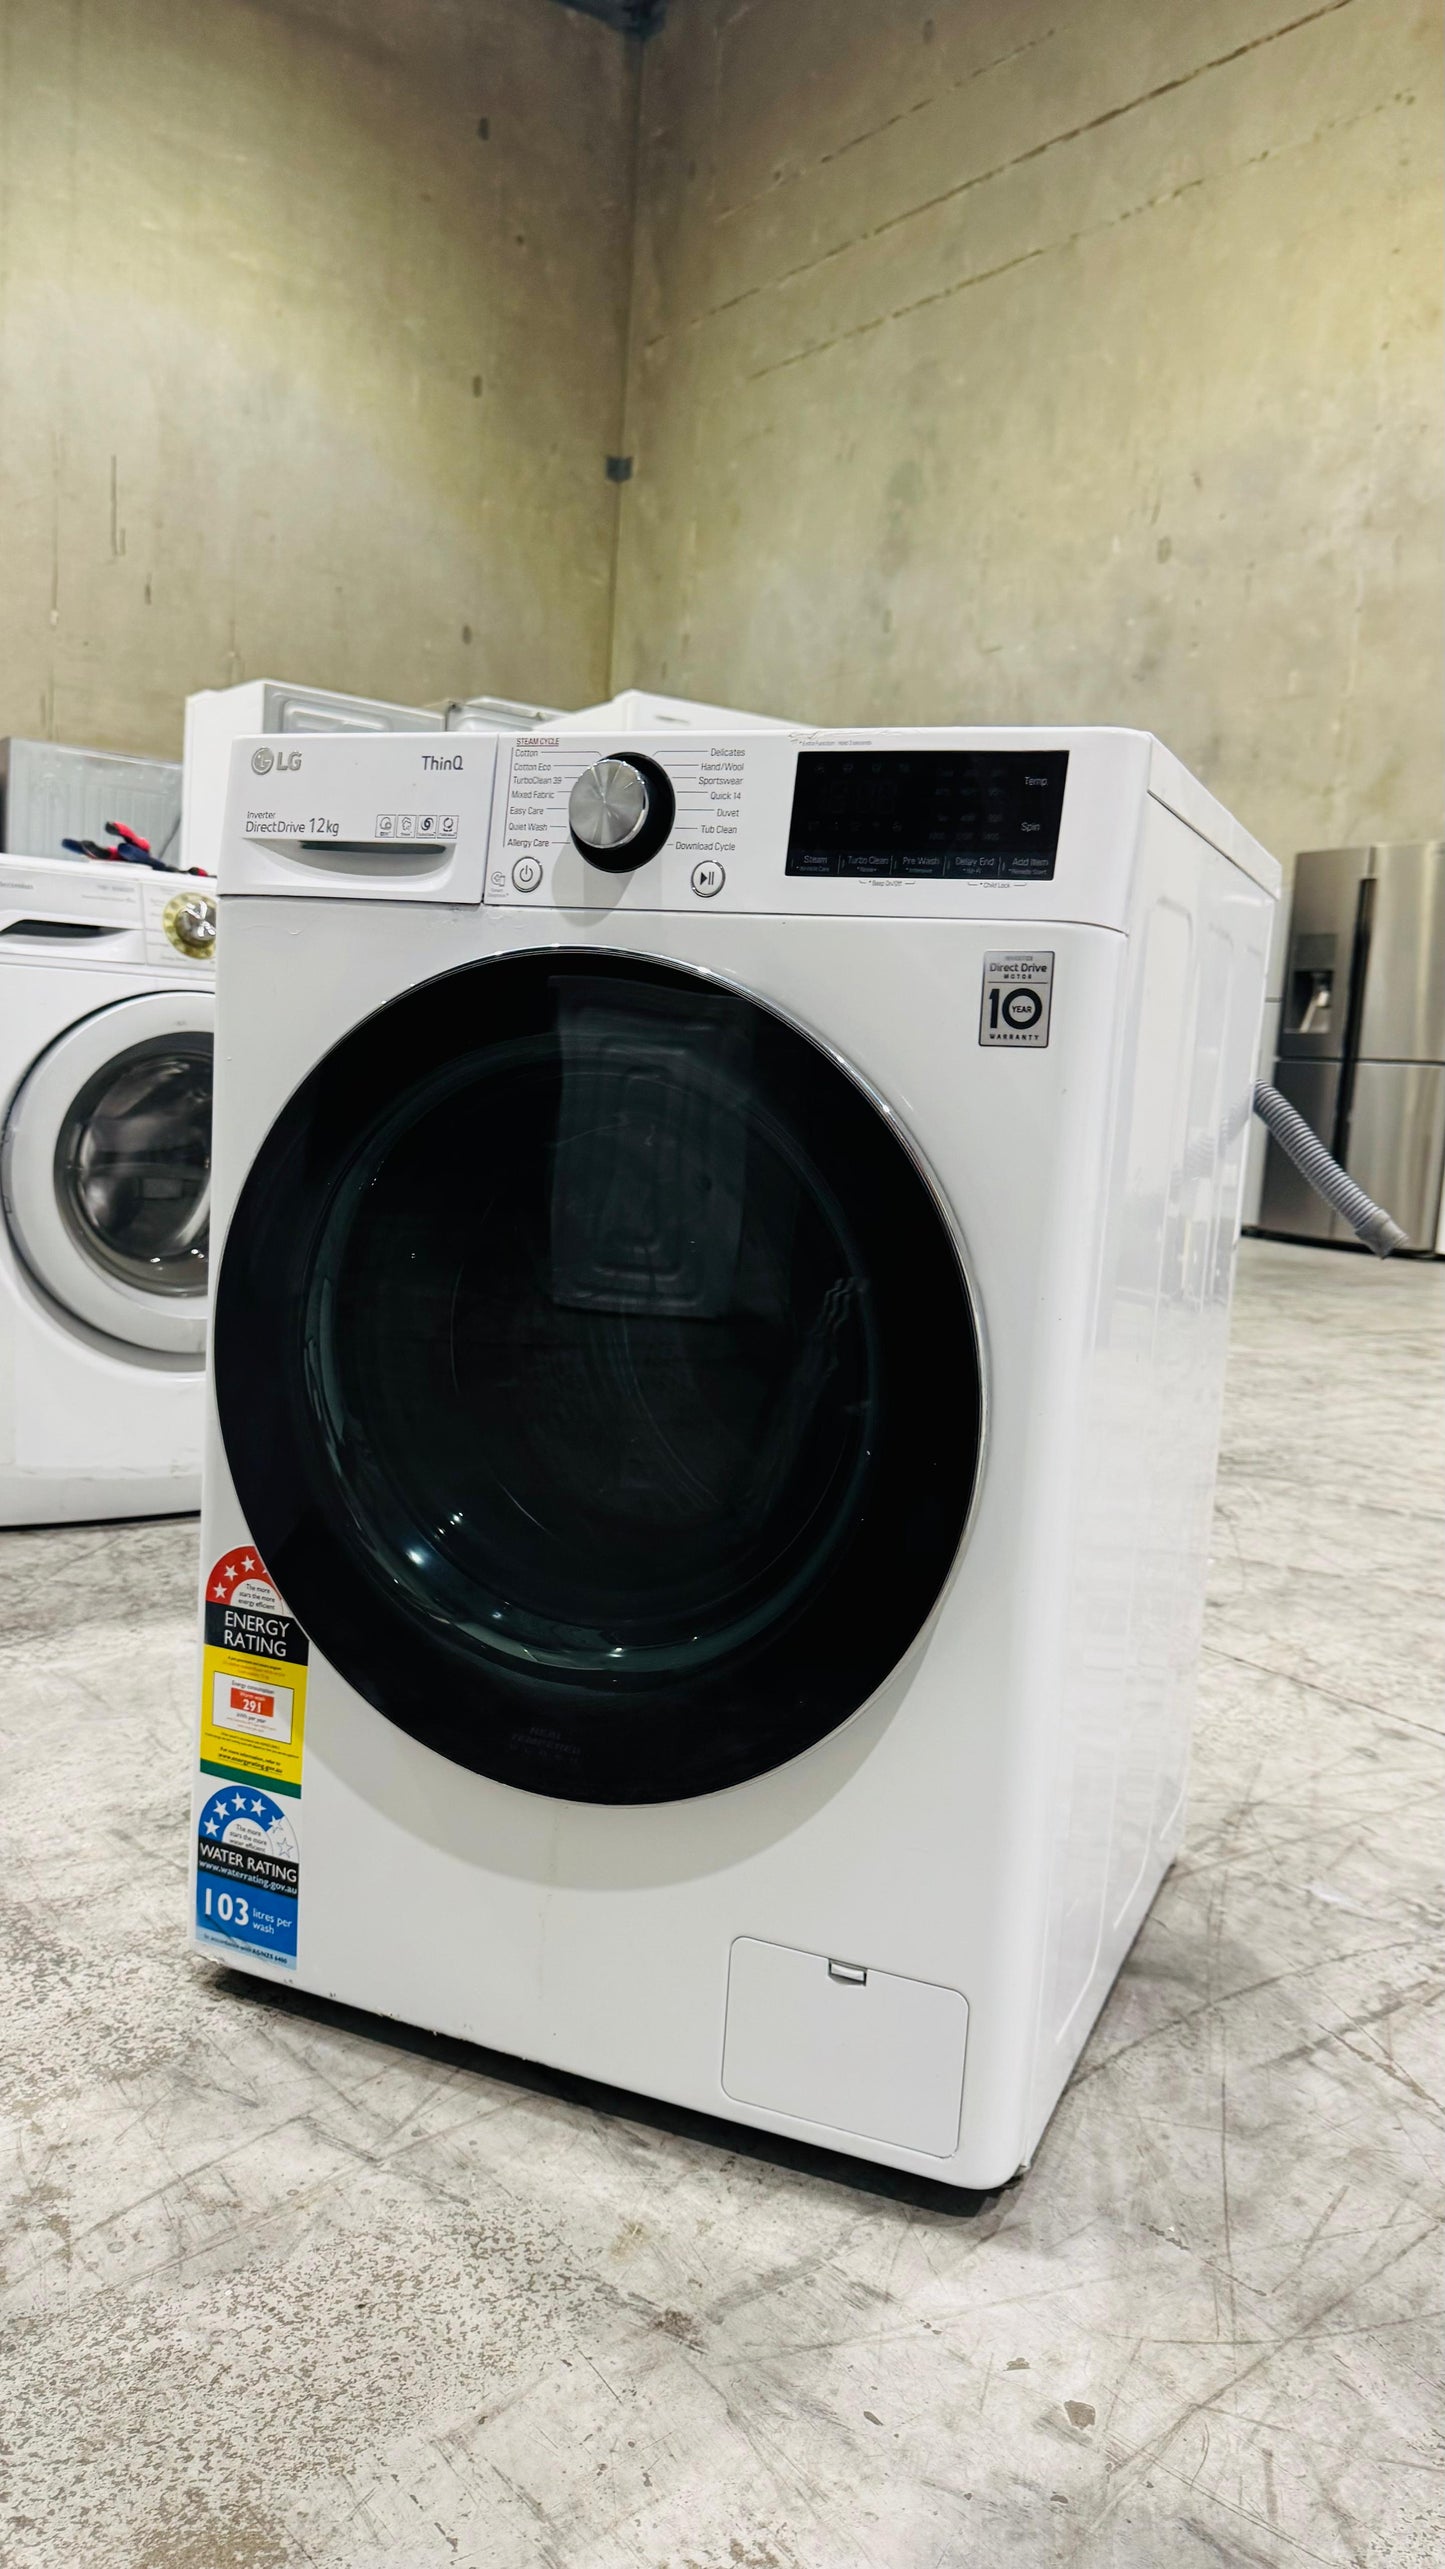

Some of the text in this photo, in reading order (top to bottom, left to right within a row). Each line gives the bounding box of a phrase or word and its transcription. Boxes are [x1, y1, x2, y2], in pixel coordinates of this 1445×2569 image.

[516, 737, 560, 746] STEAM CYCLE
[514, 749, 539, 758] Cotton
[710, 748, 746, 757] Delicates
[276, 751, 302, 771] LG
[421, 755, 464, 770] ThinQ
[513, 763, 552, 771] Cotton Eco
[701, 762, 744, 771] Hand/Wool
[513, 775, 552, 784] TurboClean
[698, 776, 744, 786] Sportswear
[511, 790, 555, 799] Mixed Fabric
[710, 791, 732, 800] Quick
[509, 806, 544, 816] Easy Care
[716, 808, 740, 818] Duvet
[309, 817, 340, 837] 12kg
[508, 822, 548, 832] Quiet Wash
[701, 824, 738, 834] Tub Clean
[1020, 821, 1041, 832] Spin
[507, 838, 550, 848] Allergy Care
[675, 841, 736, 852] Download Cycle
[803, 855, 828, 864] Steam
[902, 856, 916, 865] Pre
[979, 857, 995, 866] End
[1012, 857, 1029, 866] Add
[989, 963, 1047, 973] Direct Drive
[988, 987, 1043, 1030] 10
[1011, 1005, 1032, 1013] YEAR
[246, 1583, 256, 1591] The
[239, 1591, 252, 1599] stars
[238, 1599, 255, 1607] energy
[224, 1610, 290, 1638] ENERGY
[223, 1629, 287, 1657] RATING
[242, 1699, 262, 1713] 291
[247, 1828, 262, 1837] more
[229, 1831, 267, 1846] stars the more
[200, 1842, 297, 1883] WATER RATING
[199, 1860, 297, 1895] www.waterrating.gov.au
[205, 1888, 249, 1926] 103
[252, 1907, 292, 1928] litres per
[252, 1921, 275, 1935] wash
